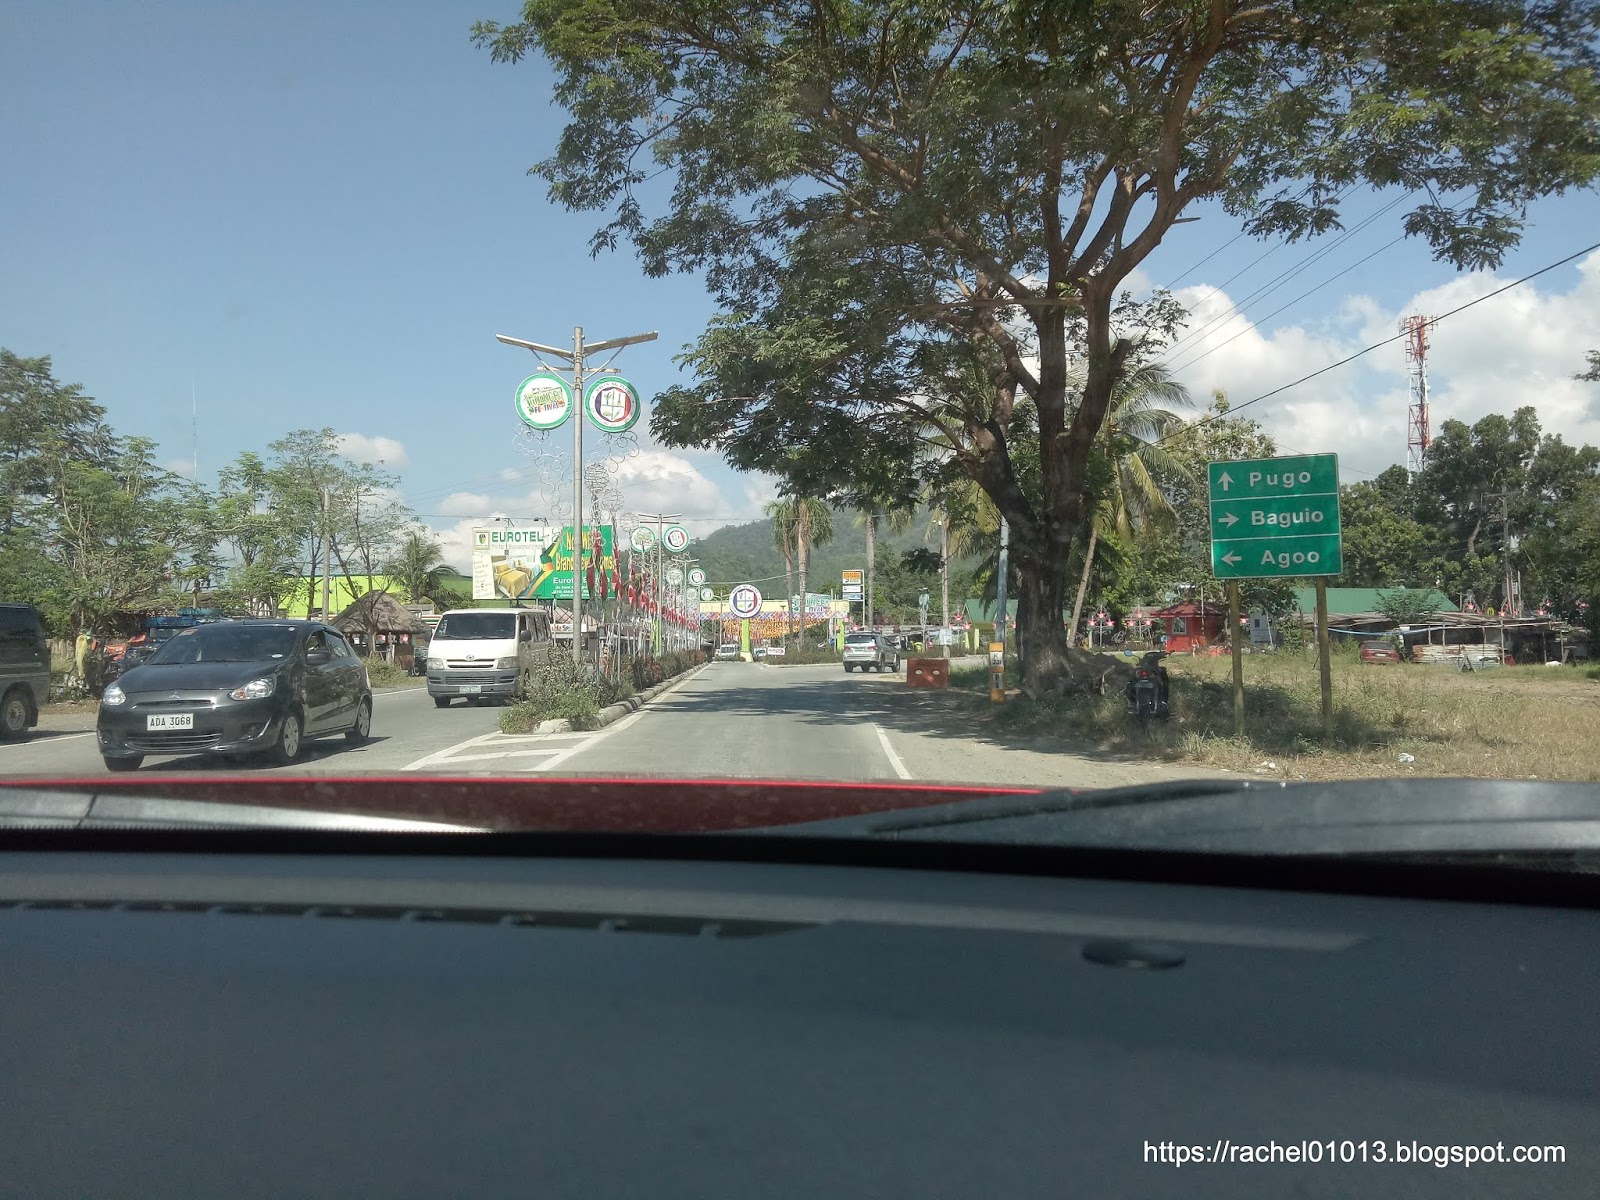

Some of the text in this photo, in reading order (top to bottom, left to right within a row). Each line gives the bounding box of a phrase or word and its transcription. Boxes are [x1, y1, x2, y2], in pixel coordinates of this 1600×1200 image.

[1249, 471, 1311, 489] Pugo
[1251, 508, 1324, 528] Baguio
[491, 531, 545, 543] EUROTEL
[1260, 549, 1320, 568] Agoo
[150, 716, 191, 726] ADA 3068
